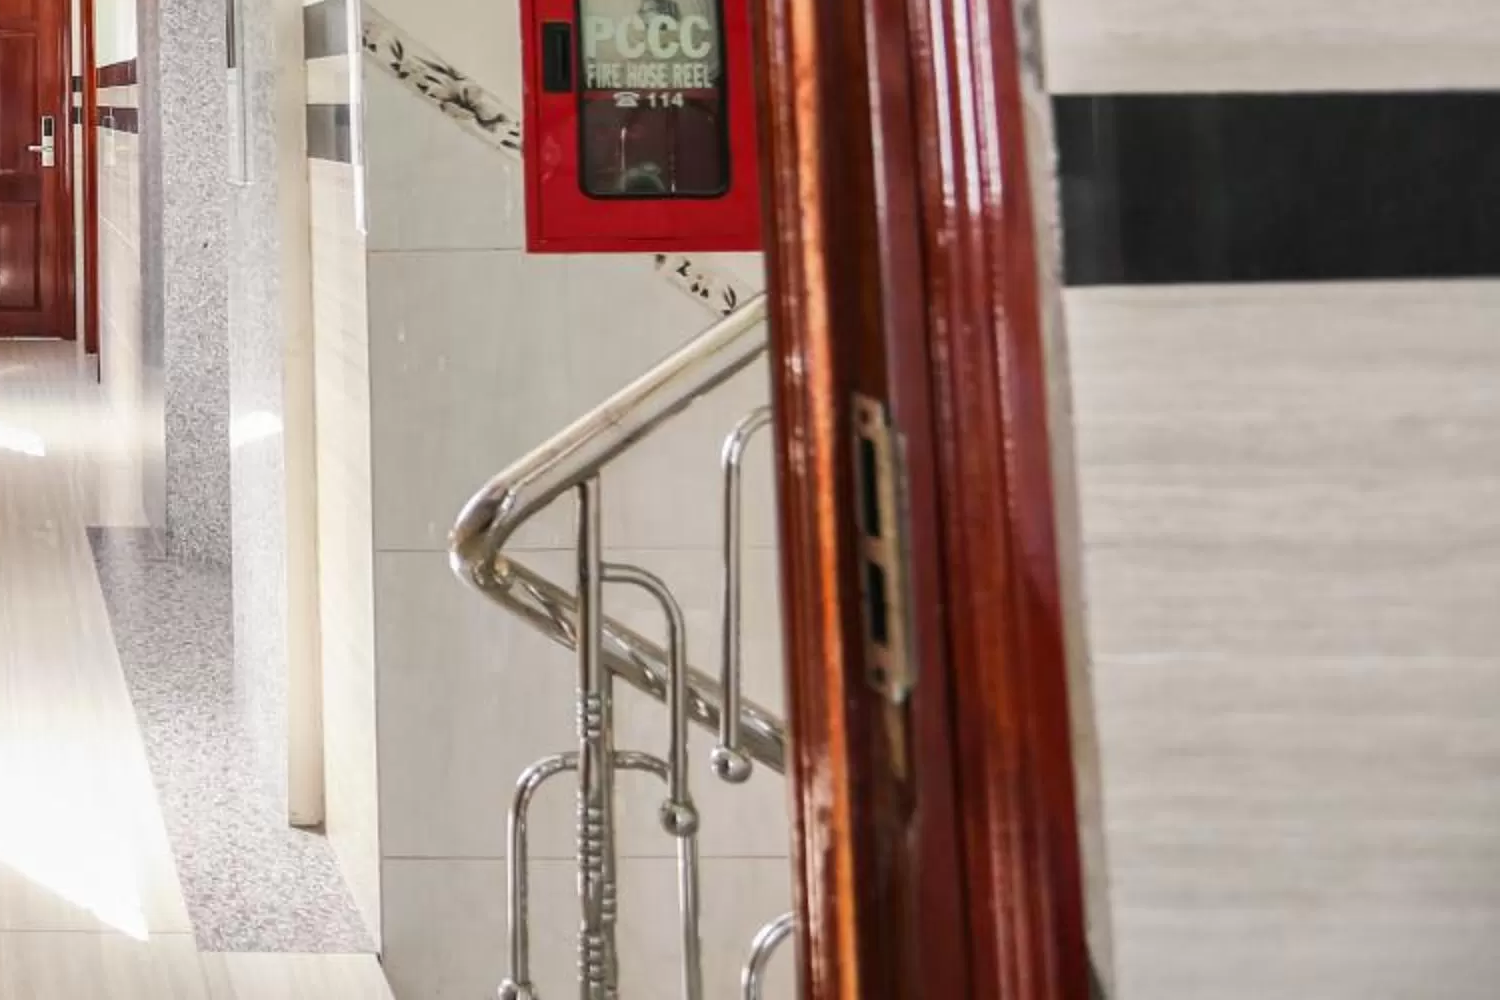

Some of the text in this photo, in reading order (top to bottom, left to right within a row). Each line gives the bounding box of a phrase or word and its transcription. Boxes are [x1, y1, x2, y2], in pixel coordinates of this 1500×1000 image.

[584, 14, 712, 59] PCCC
[586, 62, 713, 89] FIRE HOSE REEL
[646, 91, 685, 108] 114
